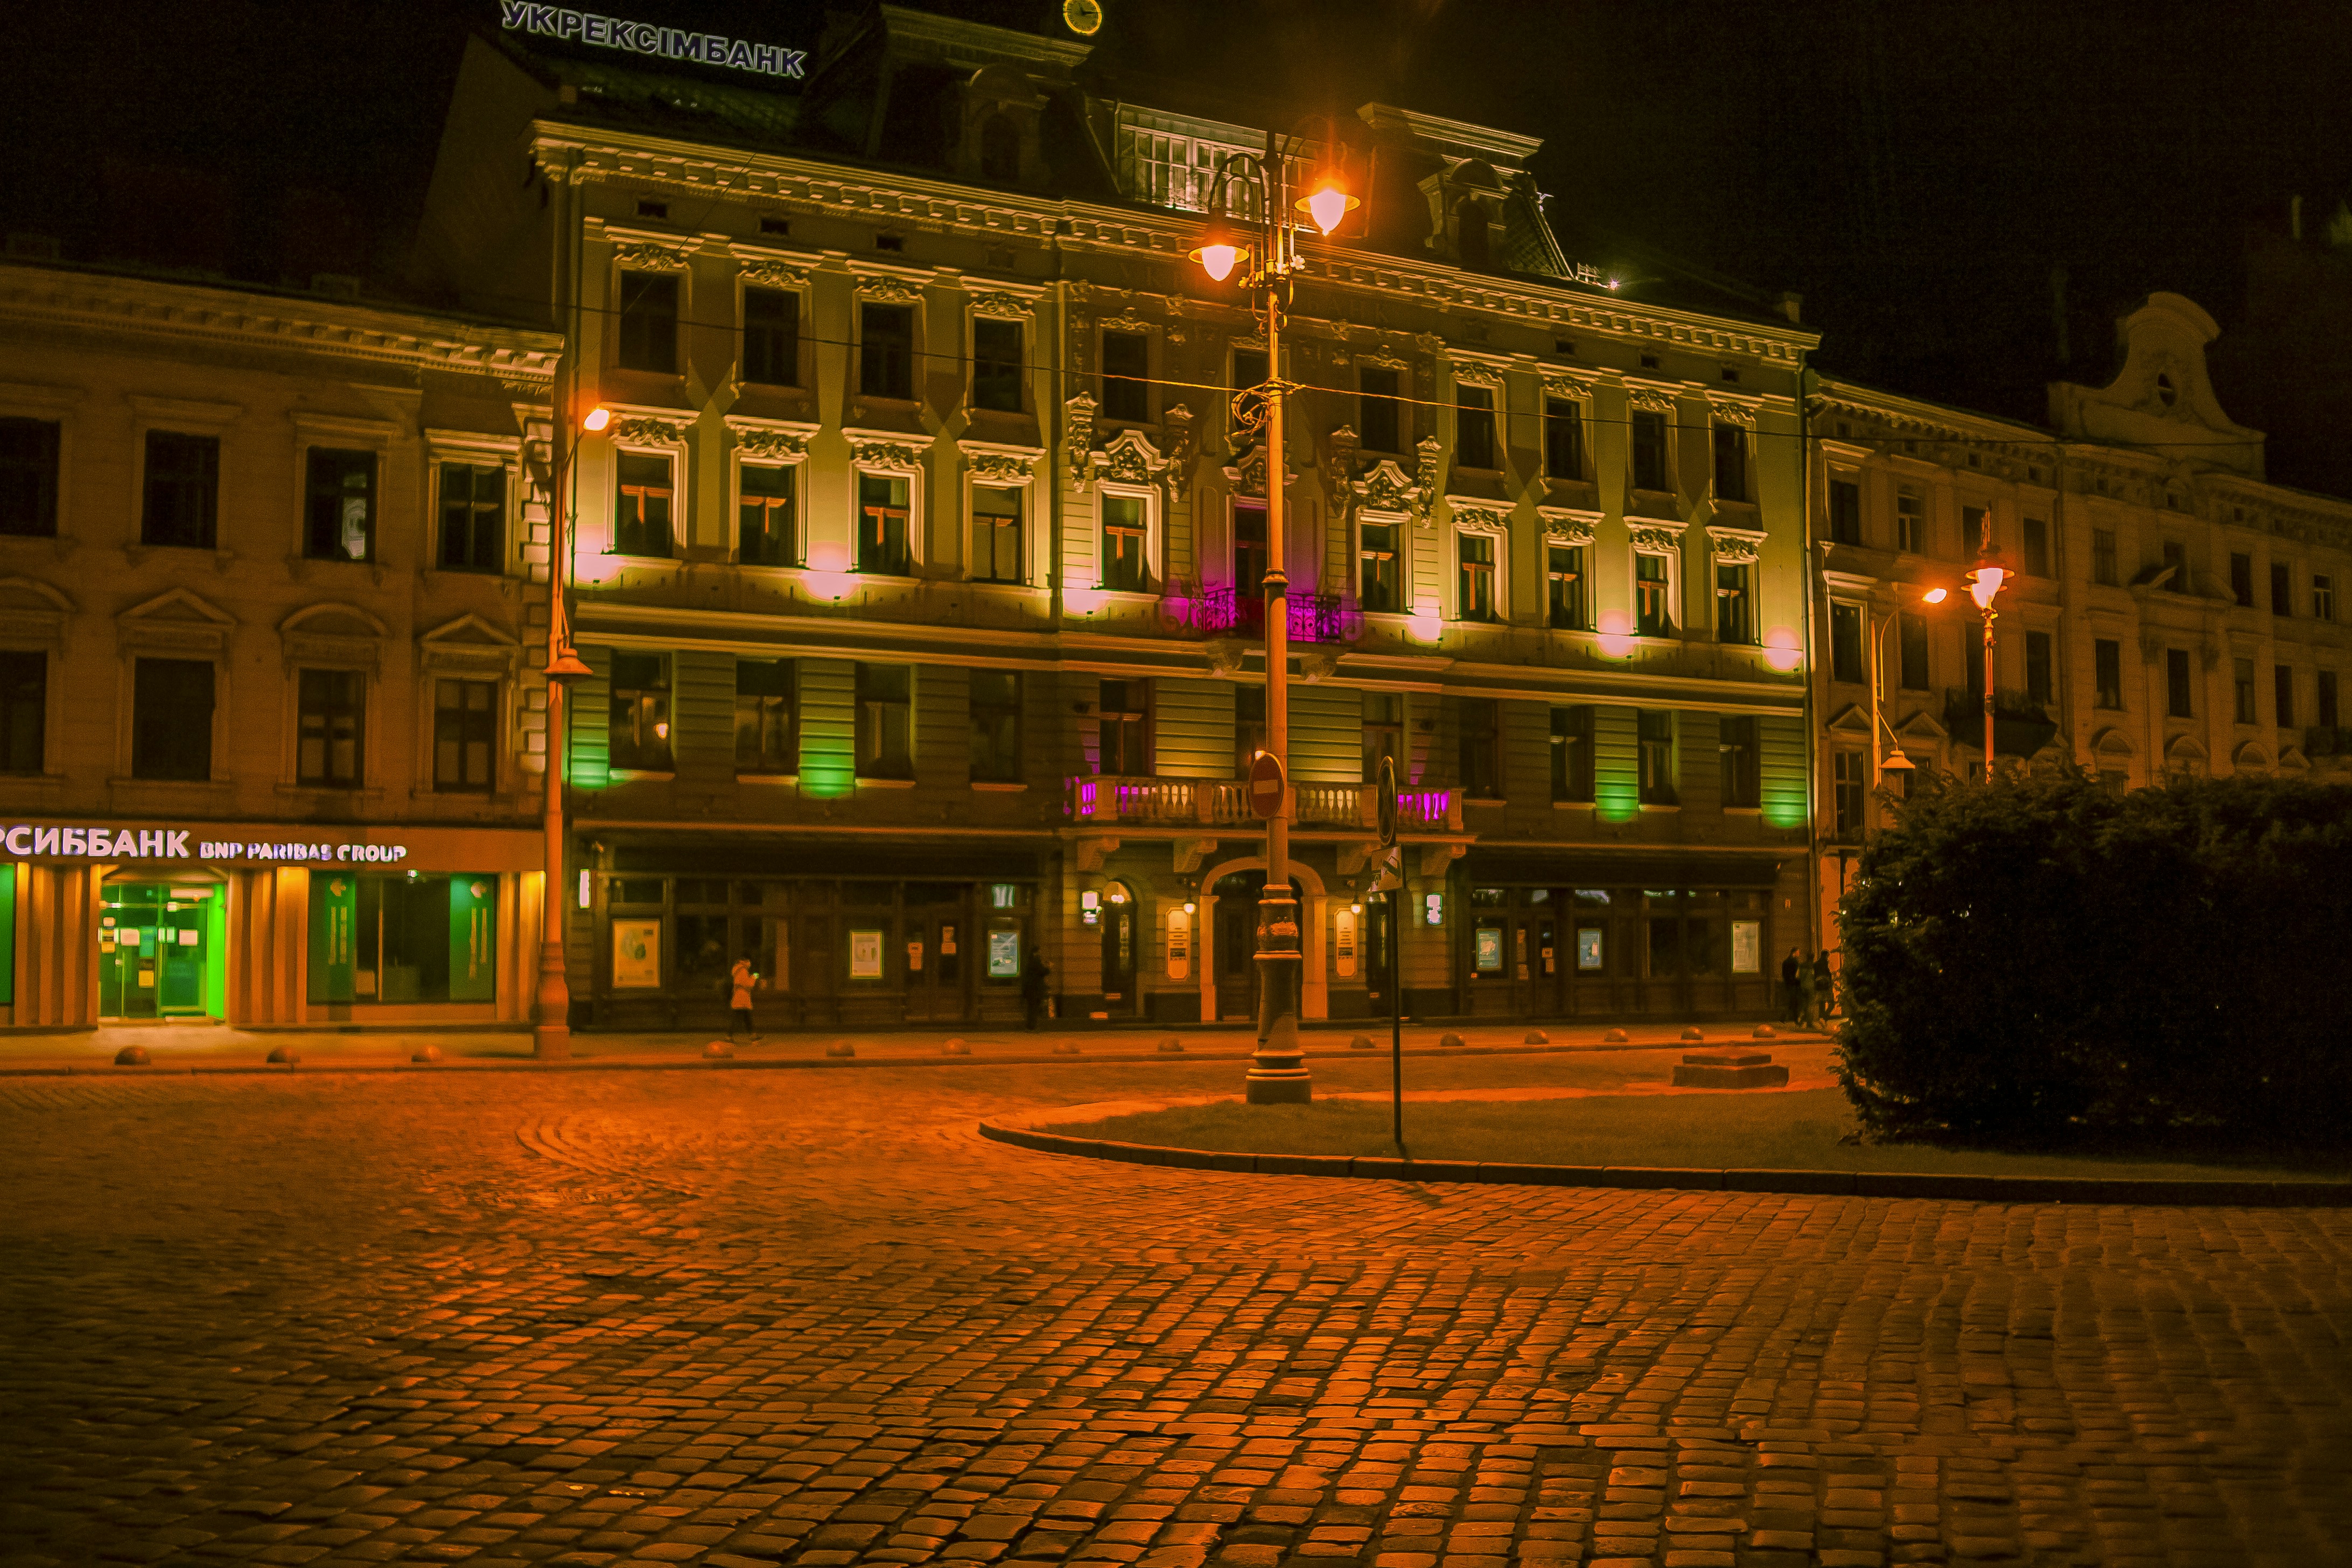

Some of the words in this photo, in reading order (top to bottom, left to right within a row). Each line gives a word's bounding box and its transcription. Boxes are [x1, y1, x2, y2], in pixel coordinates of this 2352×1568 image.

[501, 0, 807, 79] УКРЕКСІМБАНК
[200, 842, 244, 859] BNP
[247, 842, 332, 861] PARIBAS
